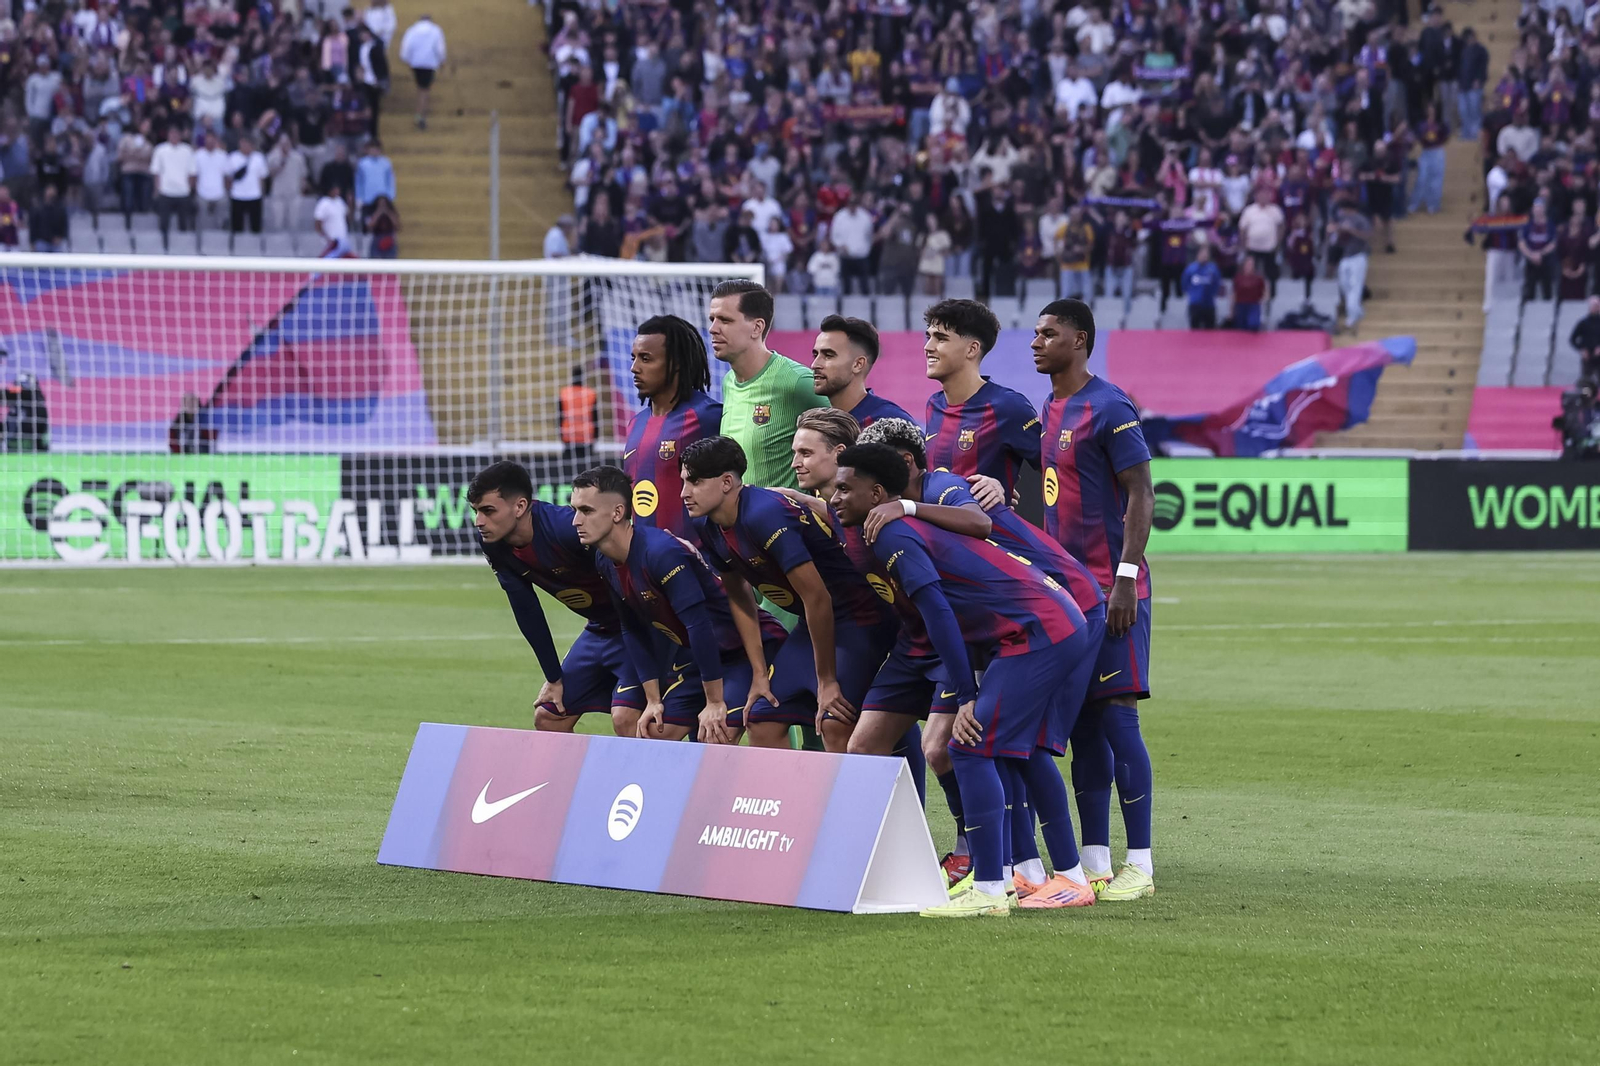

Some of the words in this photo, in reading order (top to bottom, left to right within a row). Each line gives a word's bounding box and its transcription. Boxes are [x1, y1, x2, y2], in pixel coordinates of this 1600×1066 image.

[1193, 481, 1349, 530] EQUAL
[731, 796, 782, 817] PHILIPS
[698, 824, 779, 850] AMBILIGHT
[778, 833, 794, 853] tv
